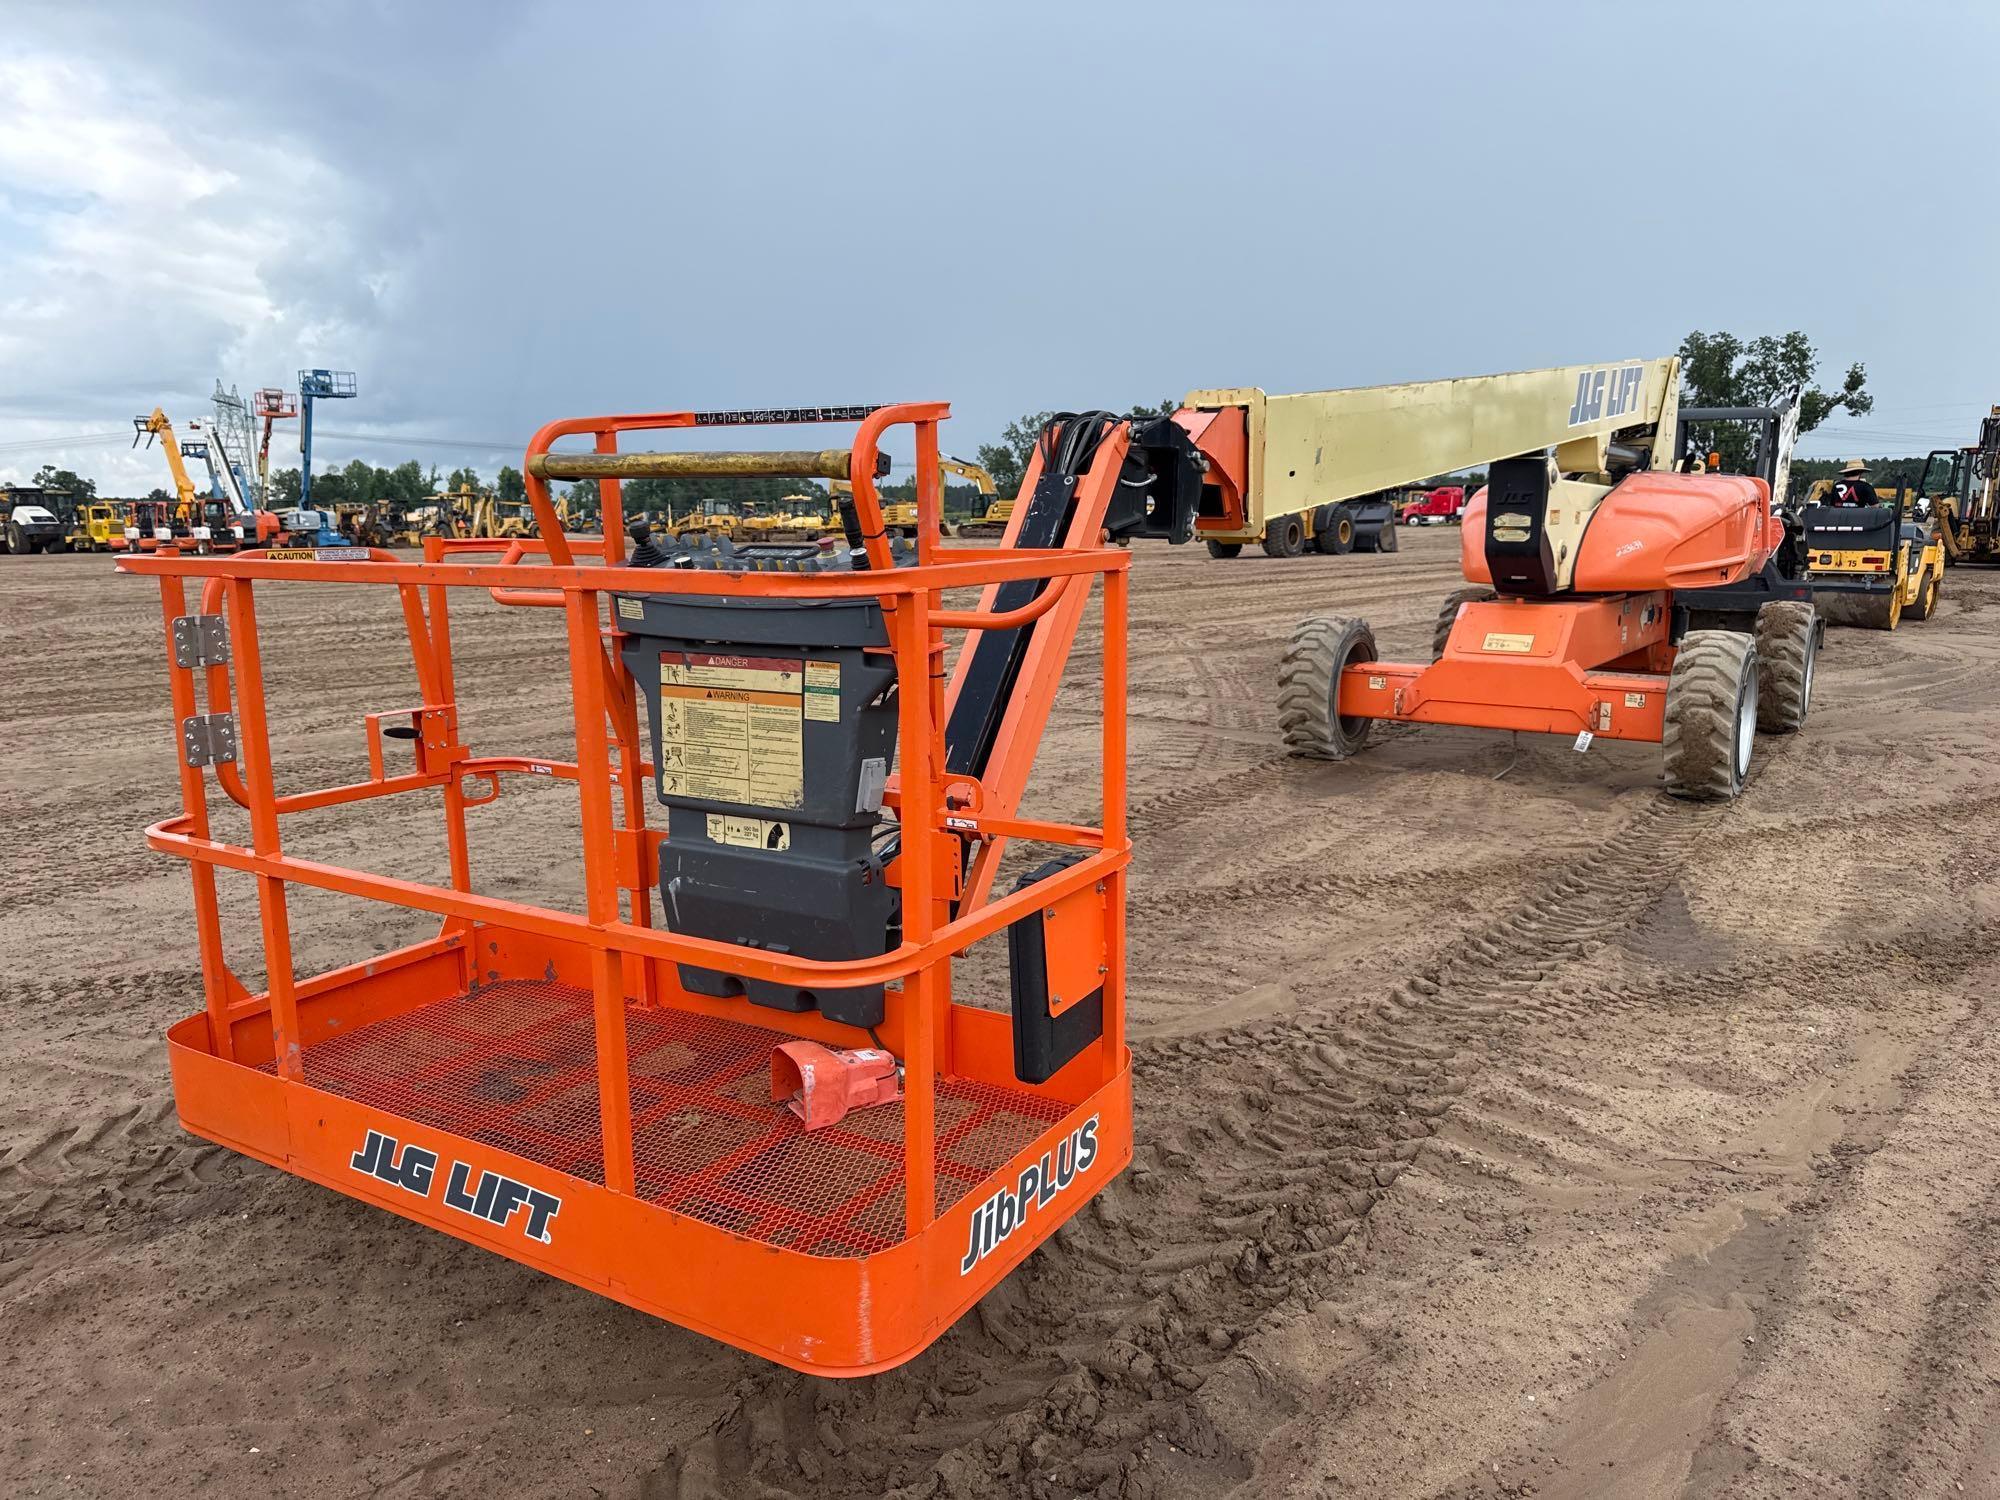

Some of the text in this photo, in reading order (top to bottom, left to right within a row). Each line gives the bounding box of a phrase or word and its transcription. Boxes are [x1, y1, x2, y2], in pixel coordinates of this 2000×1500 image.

[1568, 365, 1645, 428] JLG LIFT
[277, 551, 313, 560] CAUTION
[715, 657, 749, 667] DANGER
[713, 690, 750, 701] WARNING
[350, 1129, 562, 1243] JLG LIFT
[961, 1115, 1099, 1276] JibPLUS
